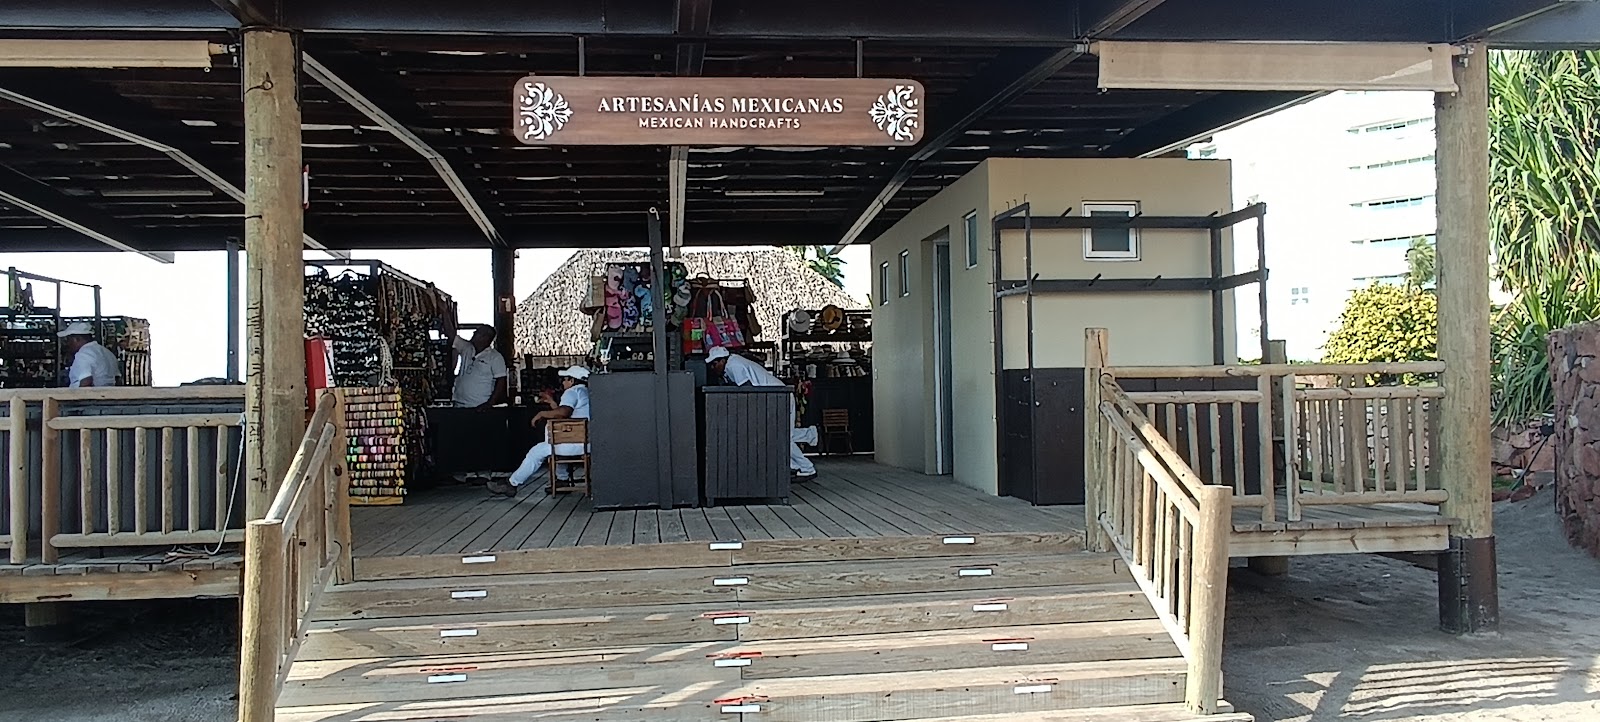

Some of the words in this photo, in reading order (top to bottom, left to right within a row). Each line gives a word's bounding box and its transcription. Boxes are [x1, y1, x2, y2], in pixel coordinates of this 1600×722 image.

[597, 94, 725, 113] ARTESANÍAS
[731, 97, 844, 113] MEXICANAS
[638, 117, 704, 128] MEXICAN
[709, 117, 801, 129] HANDCRAFTS
